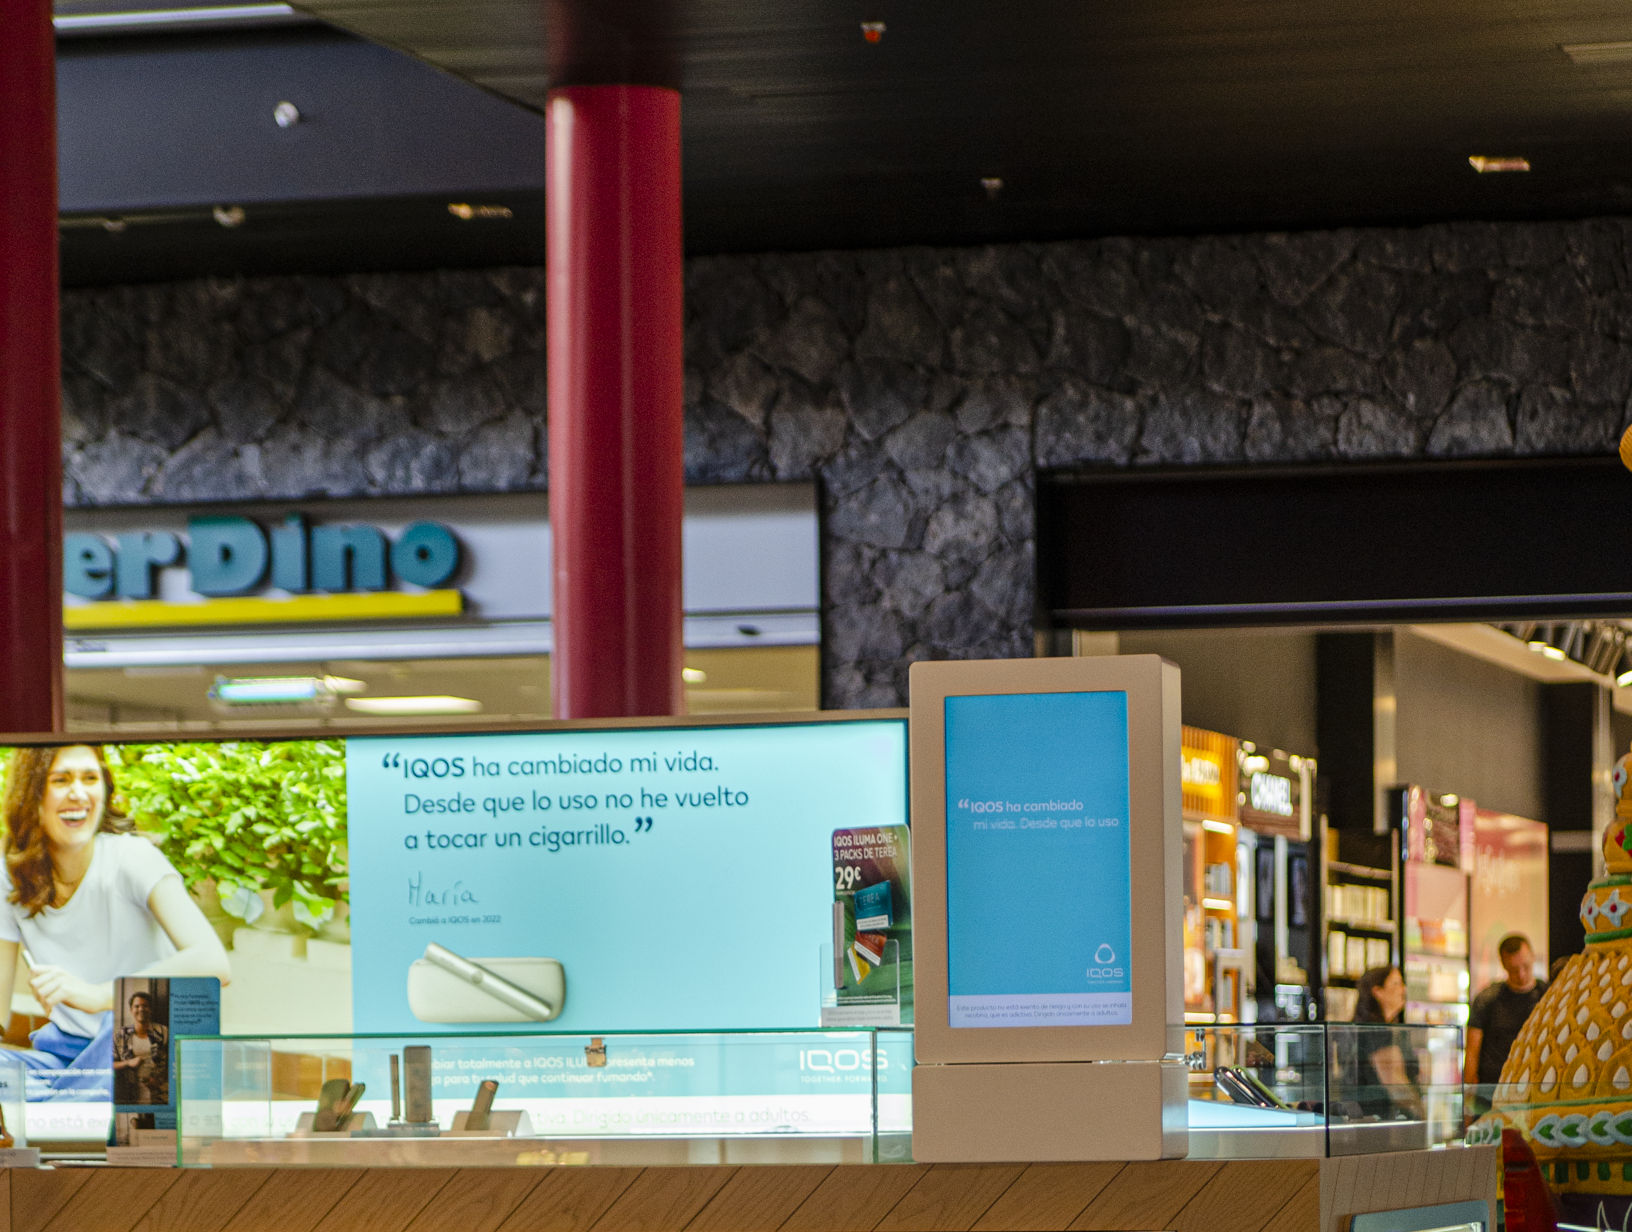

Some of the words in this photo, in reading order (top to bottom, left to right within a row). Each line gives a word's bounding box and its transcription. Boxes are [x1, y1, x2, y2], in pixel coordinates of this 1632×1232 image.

[64, 511, 459, 600] erDino
[473, 755, 501, 777] ha
[507, 753, 623, 776] cambiado
[630, 752, 657, 773] mi
[664, 751, 719, 772] vida.
[404, 792, 475, 814] Desde
[483, 794, 525, 817] que
[532, 790, 551, 810] lo
[559, 793, 598, 810] uso
[605, 793, 633, 808] no
[641, 787, 668, 808] he
[675, 786, 749, 807] vuelto
[1006, 801, 1021, 812] ha
[1023, 799, 1084, 811] cambiado
[973, 820, 988, 830] mi
[1020, 817, 1057, 829] Desde
[1060, 818, 1082, 831] que
[1085, 816, 1095, 827] lo
[1098, 818, 1119, 827] uso
[404, 831, 418, 849] a
[425, 828, 487, 848] tocar
[495, 829, 521, 847] un
[834, 835, 852, 847] IQOS
[853, 833, 876, 845] ILUMA
[877, 833, 893, 844] ONE
[834, 850, 839, 861] 3
[840, 848, 863, 860] PACKS
[864, 848, 874, 859] DE
[874, 846, 898, 858] TEREA
[835, 866, 861, 890] 29€
[1086, 967, 1124, 979] IQOS
[431, 1058, 455, 1069] biar
[458, 1058, 522, 1069] totalmente
[524, 1060, 532, 1068] a
[533, 1057, 564, 1068] IQOS
[566, 1056, 587, 1067] ILU
[657, 1057, 695, 1067] menos
[800, 1049, 889, 1073] IQOS
[443, 1075, 470, 1087] para
[518, 1074, 538, 1086] que
[541, 1071, 595, 1083] continuar
[801, 1075, 843, 1084] TOGETHER.
